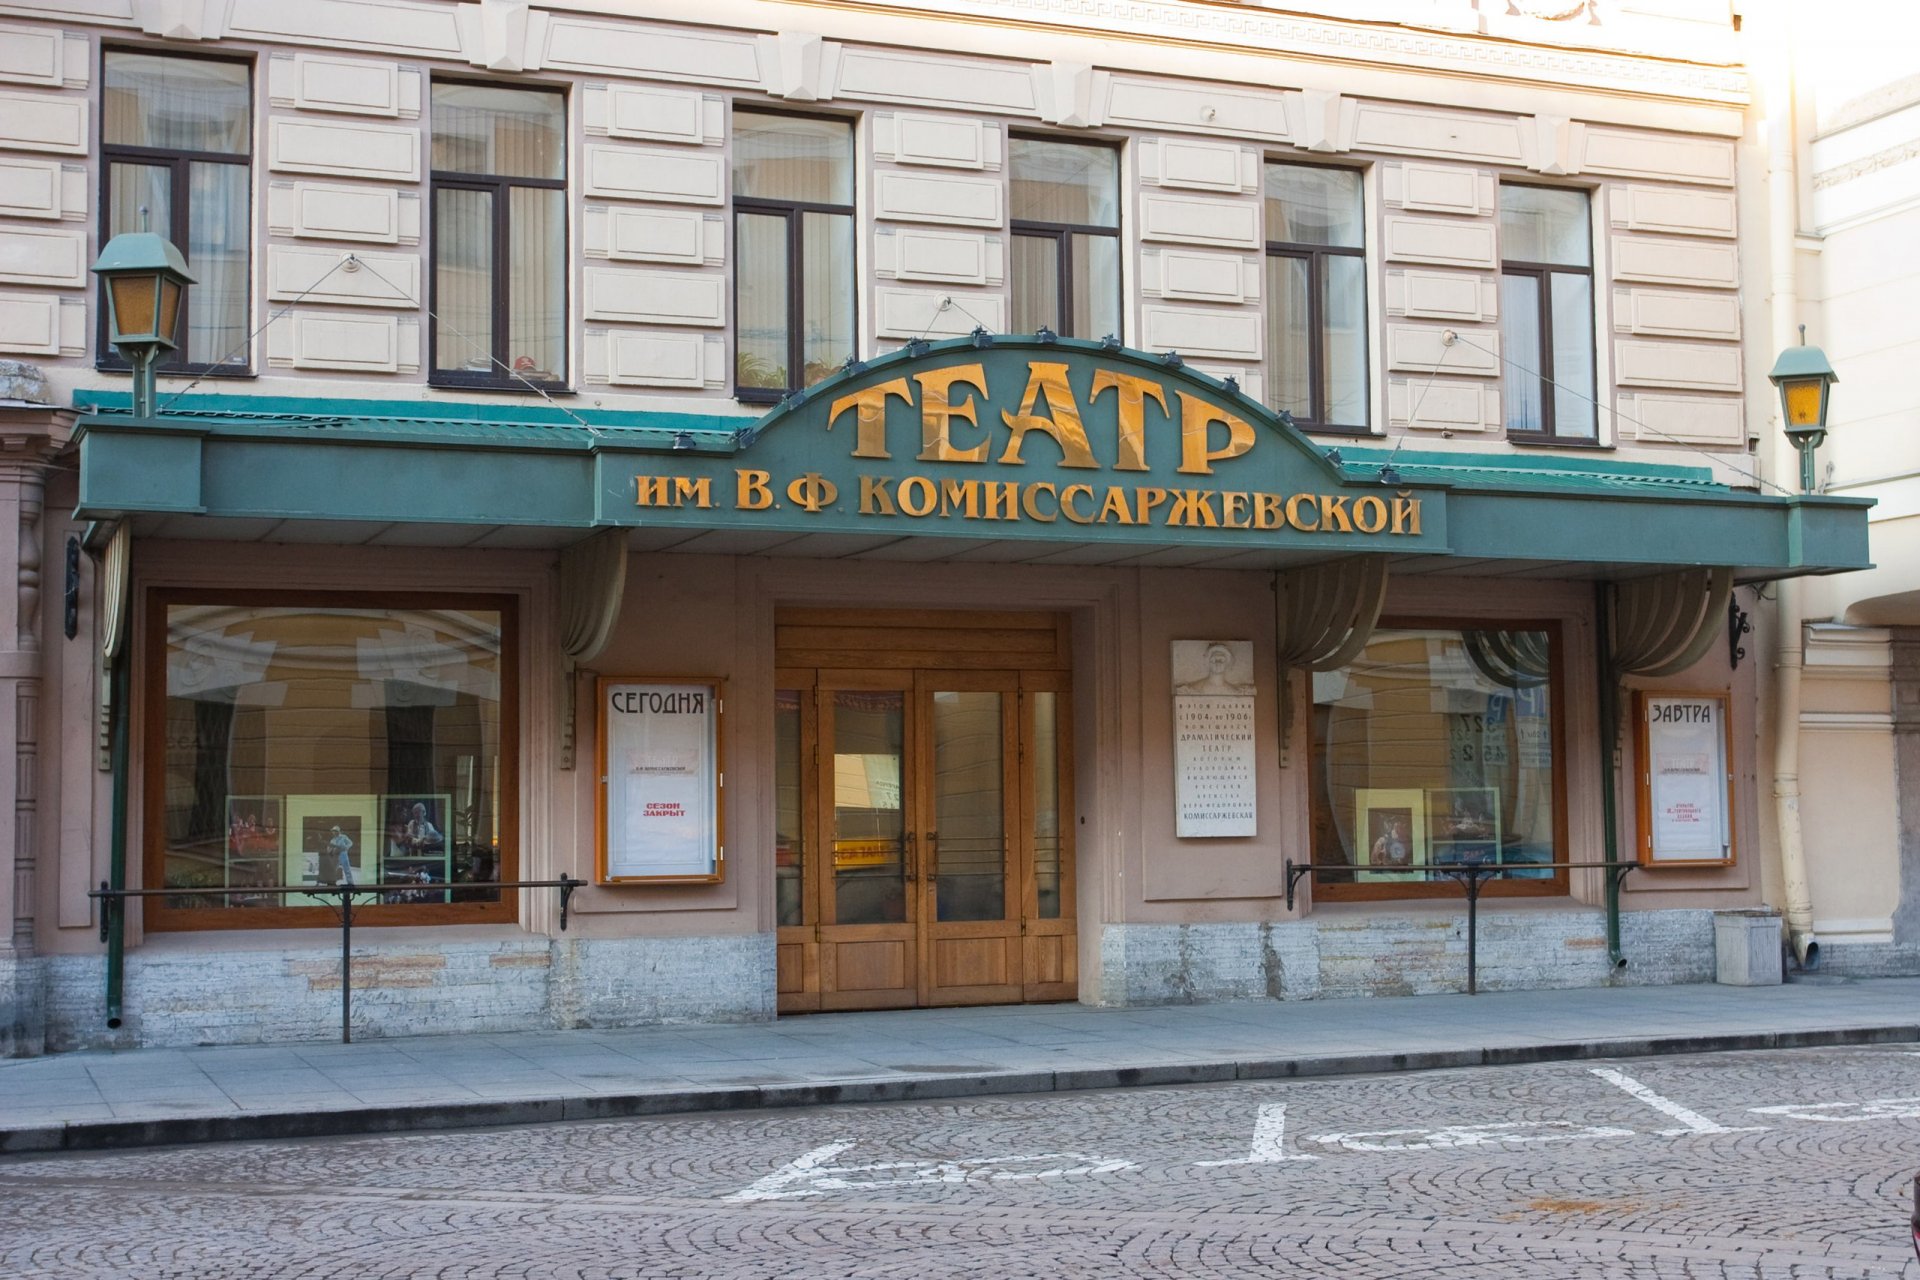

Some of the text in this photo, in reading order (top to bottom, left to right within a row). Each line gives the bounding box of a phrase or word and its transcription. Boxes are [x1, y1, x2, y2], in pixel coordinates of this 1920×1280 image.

[827, 361, 1256, 475] ТЕАТР
[858, 474, 1422, 535] КОМИССАРЖЕВСКОЙ
[611, 692, 704, 713] СЕГОДНЯ
[1652, 704, 1711, 723] ЗАВТРА
